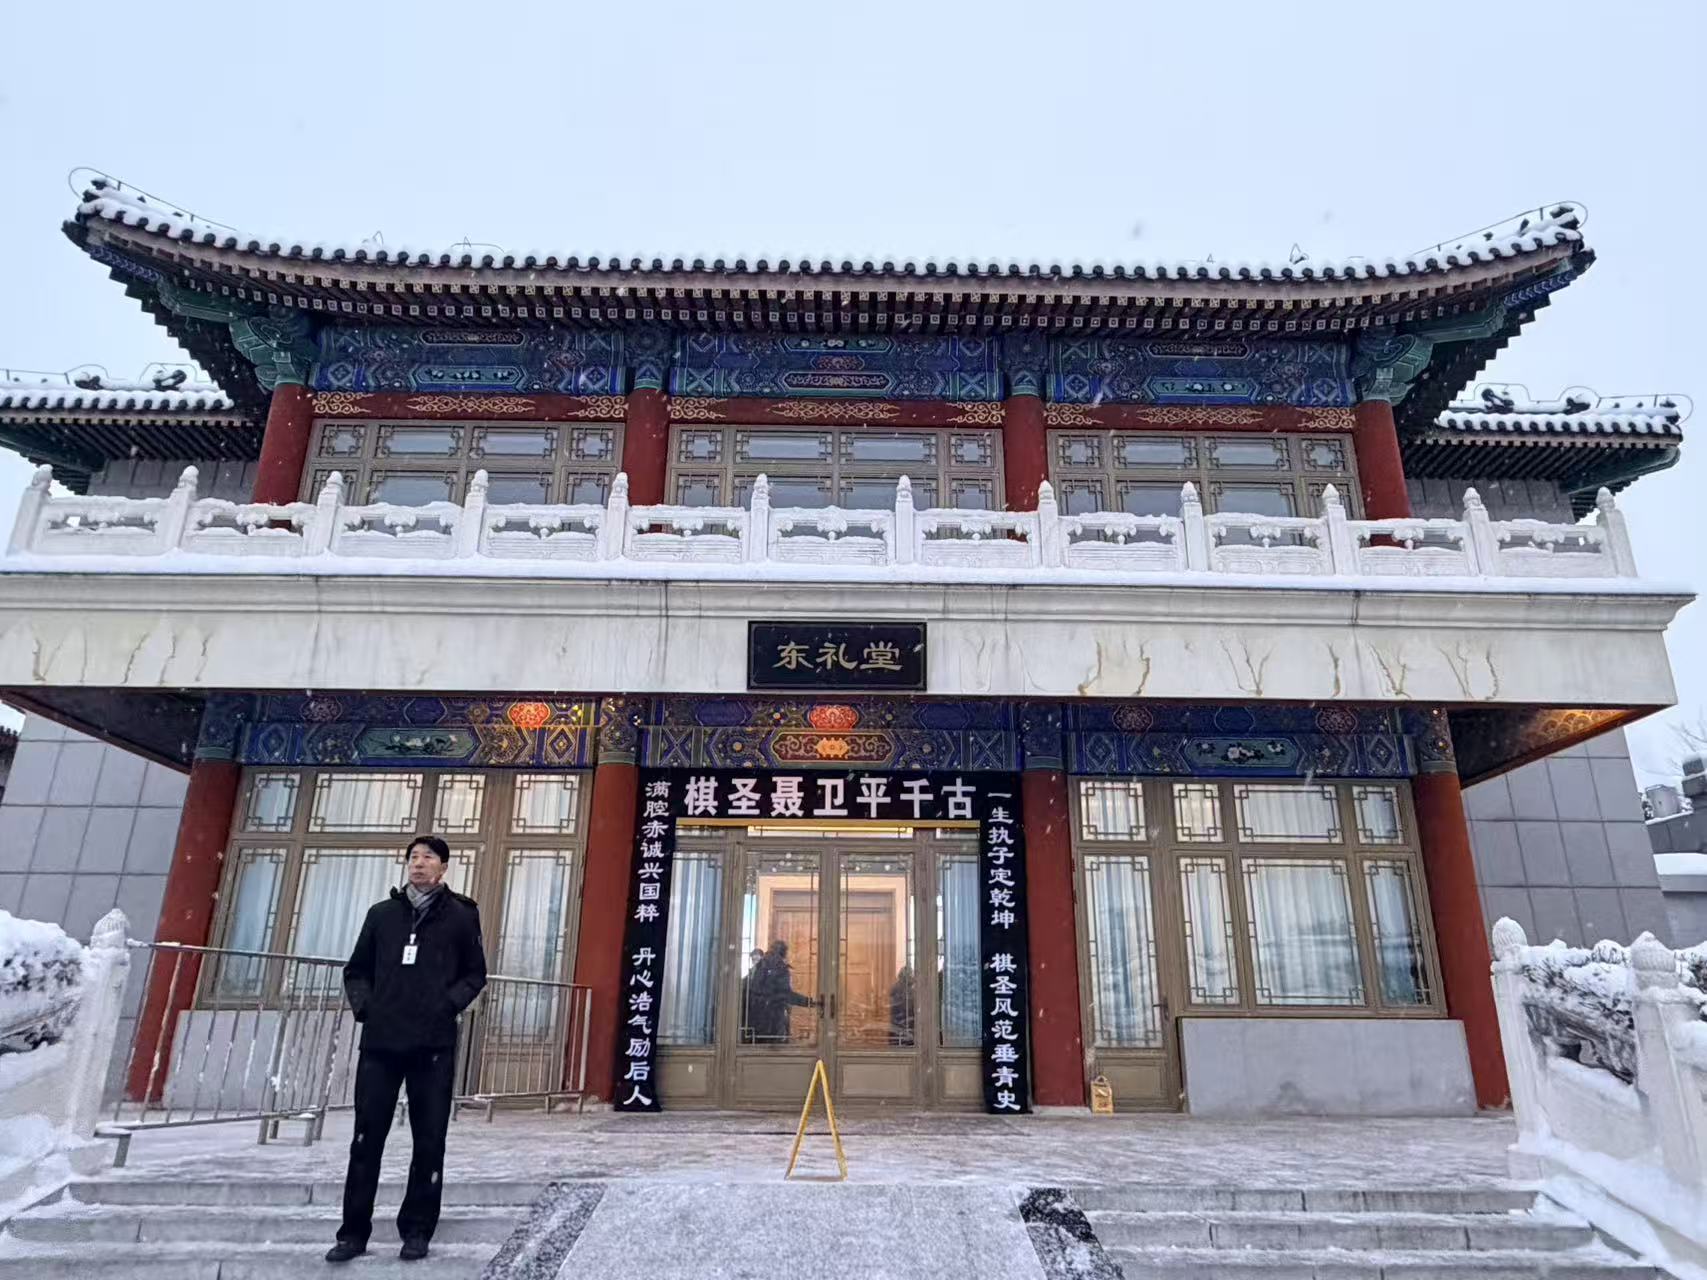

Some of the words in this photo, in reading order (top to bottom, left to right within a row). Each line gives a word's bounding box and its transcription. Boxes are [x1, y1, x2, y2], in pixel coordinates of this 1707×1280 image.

[772, 641, 903, 671] 东礼堂
[634, 781, 672, 923] 满腔赤诚兴国粹
[684, 776, 977, 819] 棋圣聂卫平千古
[987, 792, 1016, 930] 一生执子定乾坤
[623, 947, 656, 1106] 丹心浩气励后人
[989, 953, 1021, 1111] 棋圣风范垂青史
